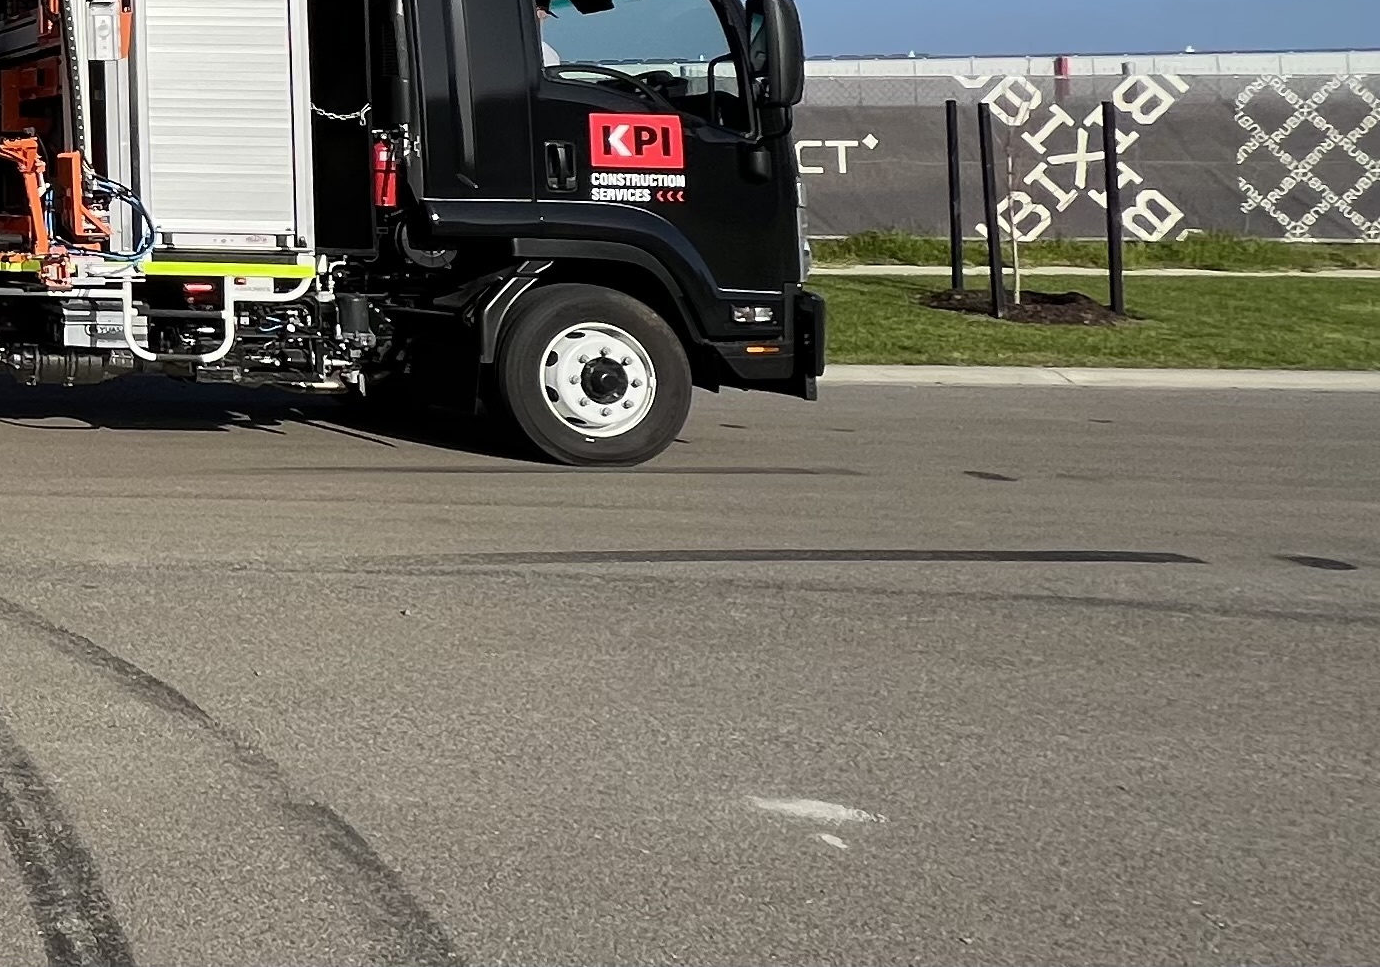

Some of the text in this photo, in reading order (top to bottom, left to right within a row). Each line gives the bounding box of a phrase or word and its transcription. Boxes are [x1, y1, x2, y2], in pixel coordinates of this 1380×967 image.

[602, 124, 671, 157] KPI
[590, 172, 686, 188] CONSTRUCTION
[590, 187, 652, 202] SERVICES
